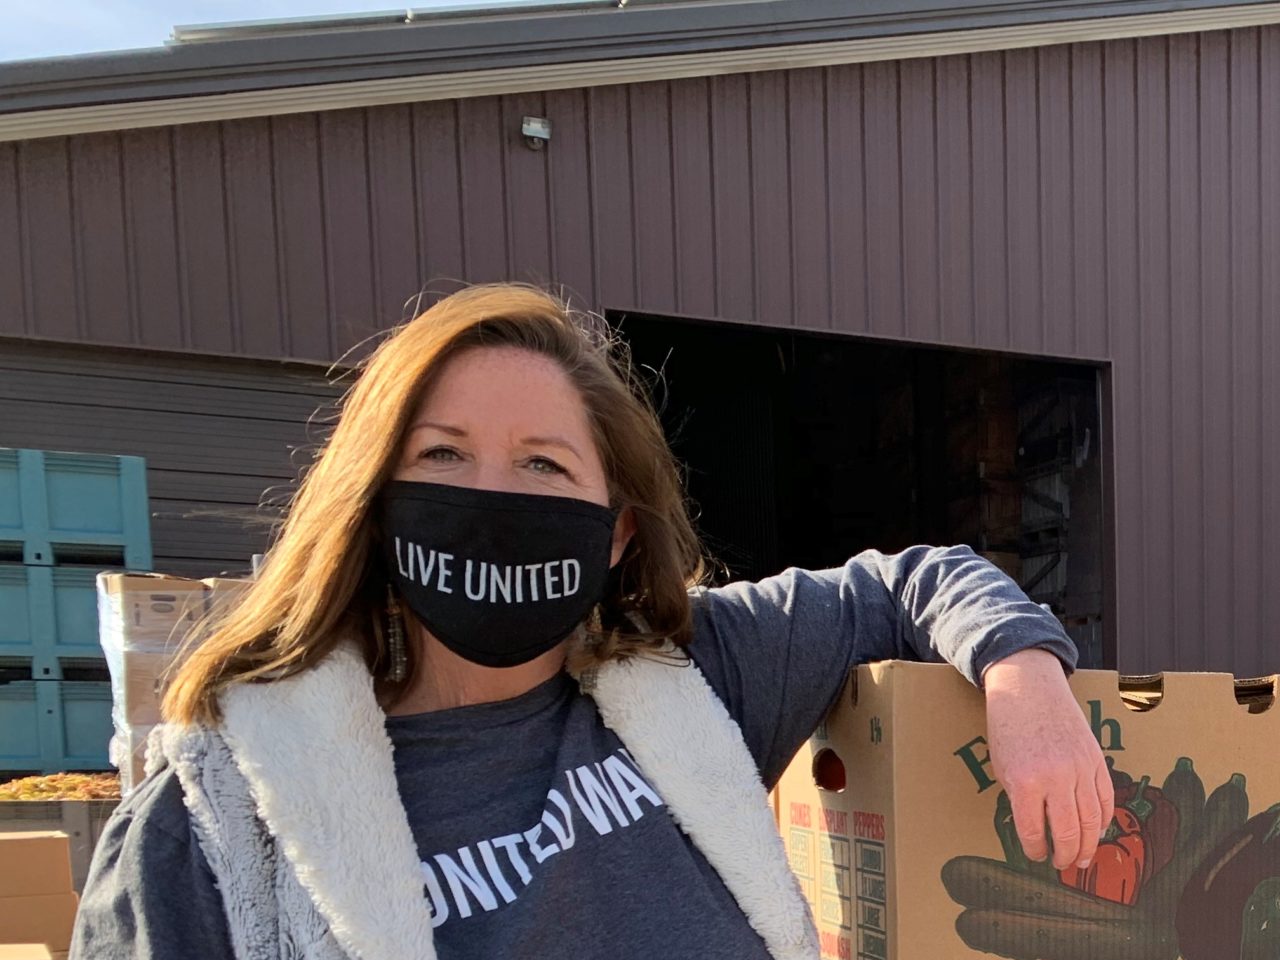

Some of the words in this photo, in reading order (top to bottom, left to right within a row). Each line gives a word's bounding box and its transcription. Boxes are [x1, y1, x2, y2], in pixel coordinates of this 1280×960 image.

[395, 536, 454, 595] LIVE
[464, 558, 581, 603] UNITED
[565, 748, 664, 836] WA
[853, 810, 885, 841] PEPPERS
